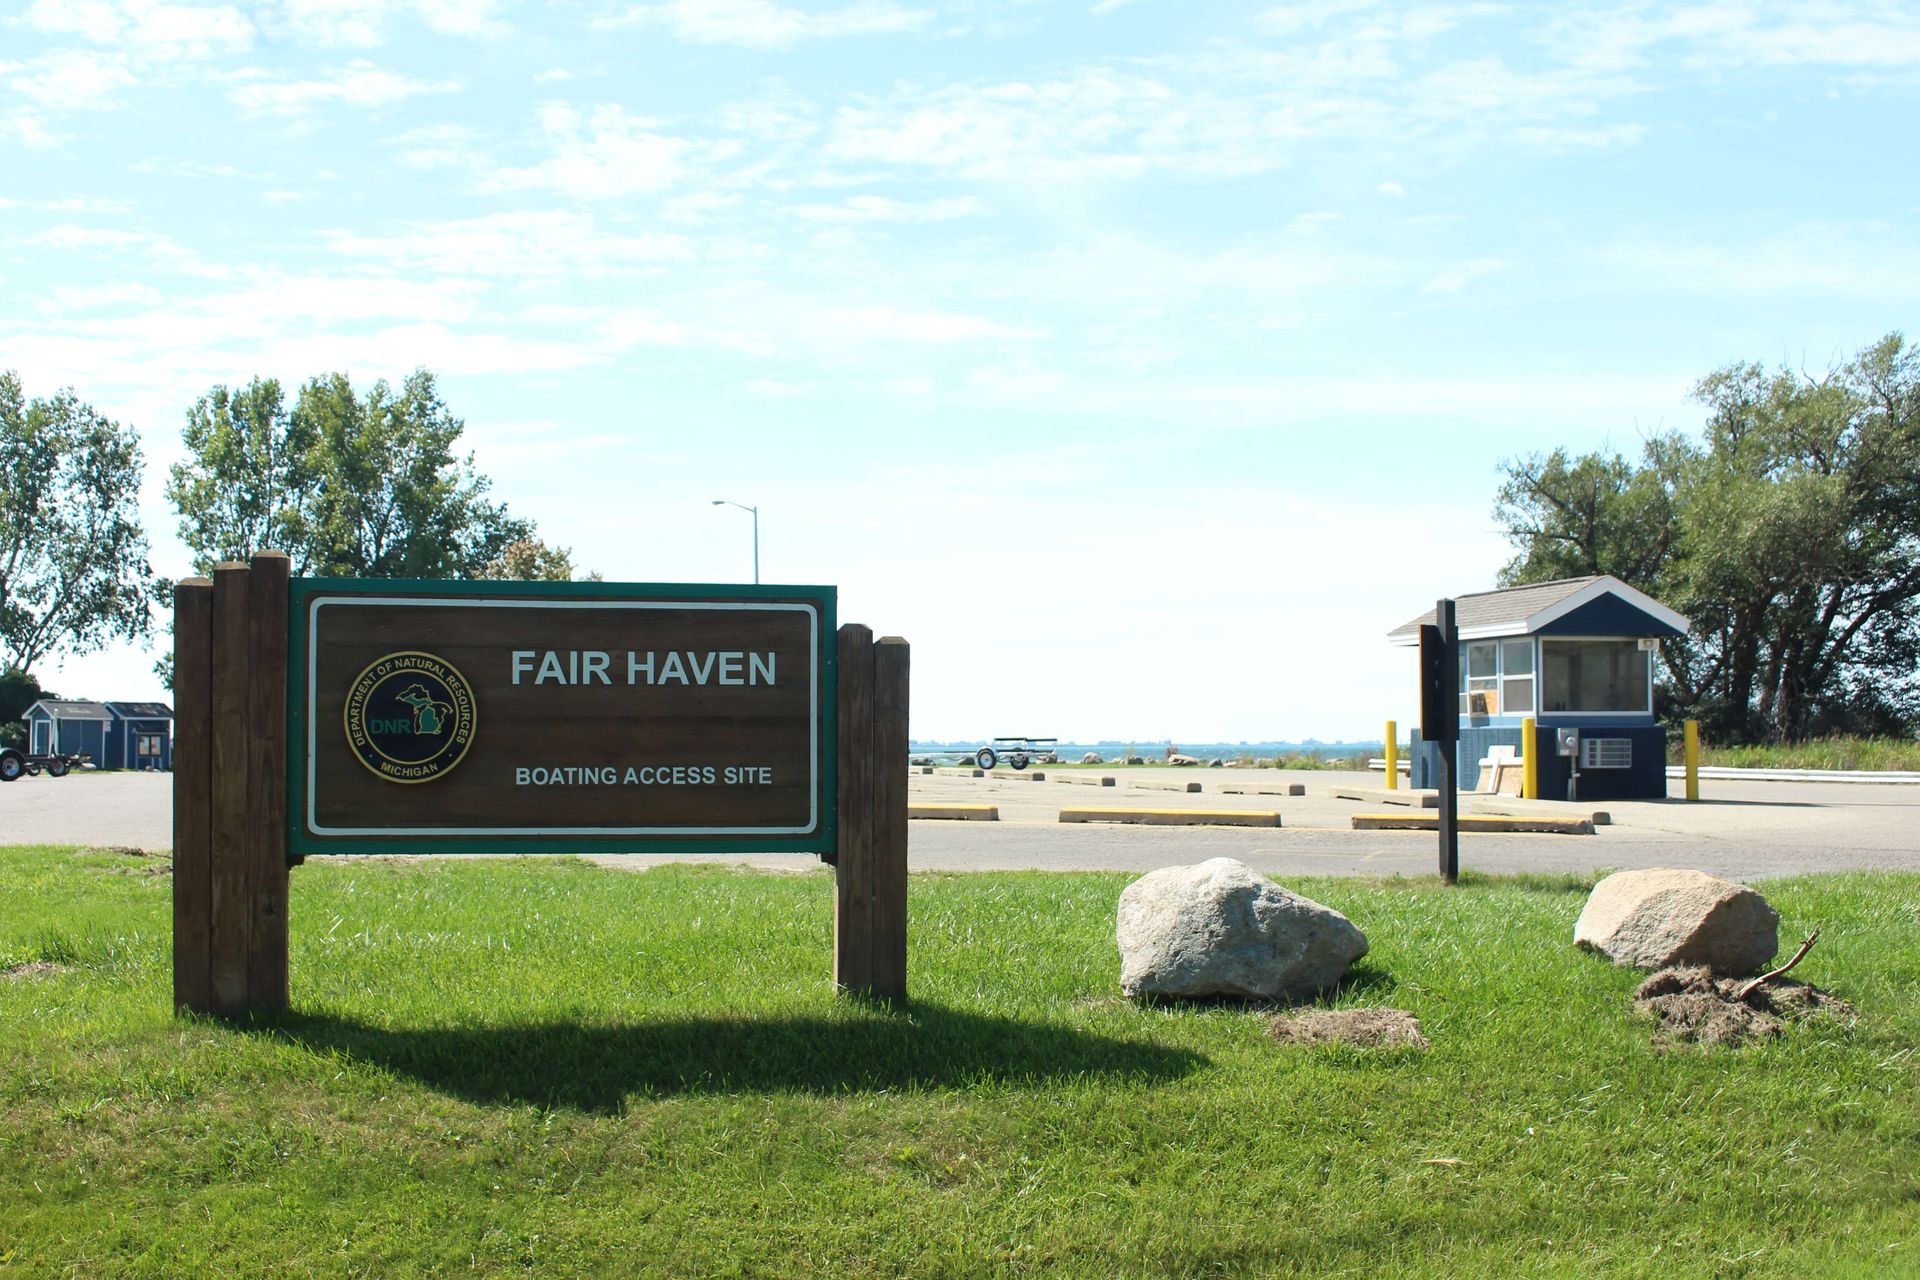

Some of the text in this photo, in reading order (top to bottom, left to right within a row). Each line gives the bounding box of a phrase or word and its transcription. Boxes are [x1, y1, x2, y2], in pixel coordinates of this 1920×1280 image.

[511, 650, 776, 685] FAIR HAVEN
[350, 658, 471, 746] DEPARTMENT OF NATURAL RESOURCES
[370, 719, 411, 734] DNR
[380, 762, 439, 777] MICHIGAN
[515, 766, 773, 785] BOATING ACCESS SITE
